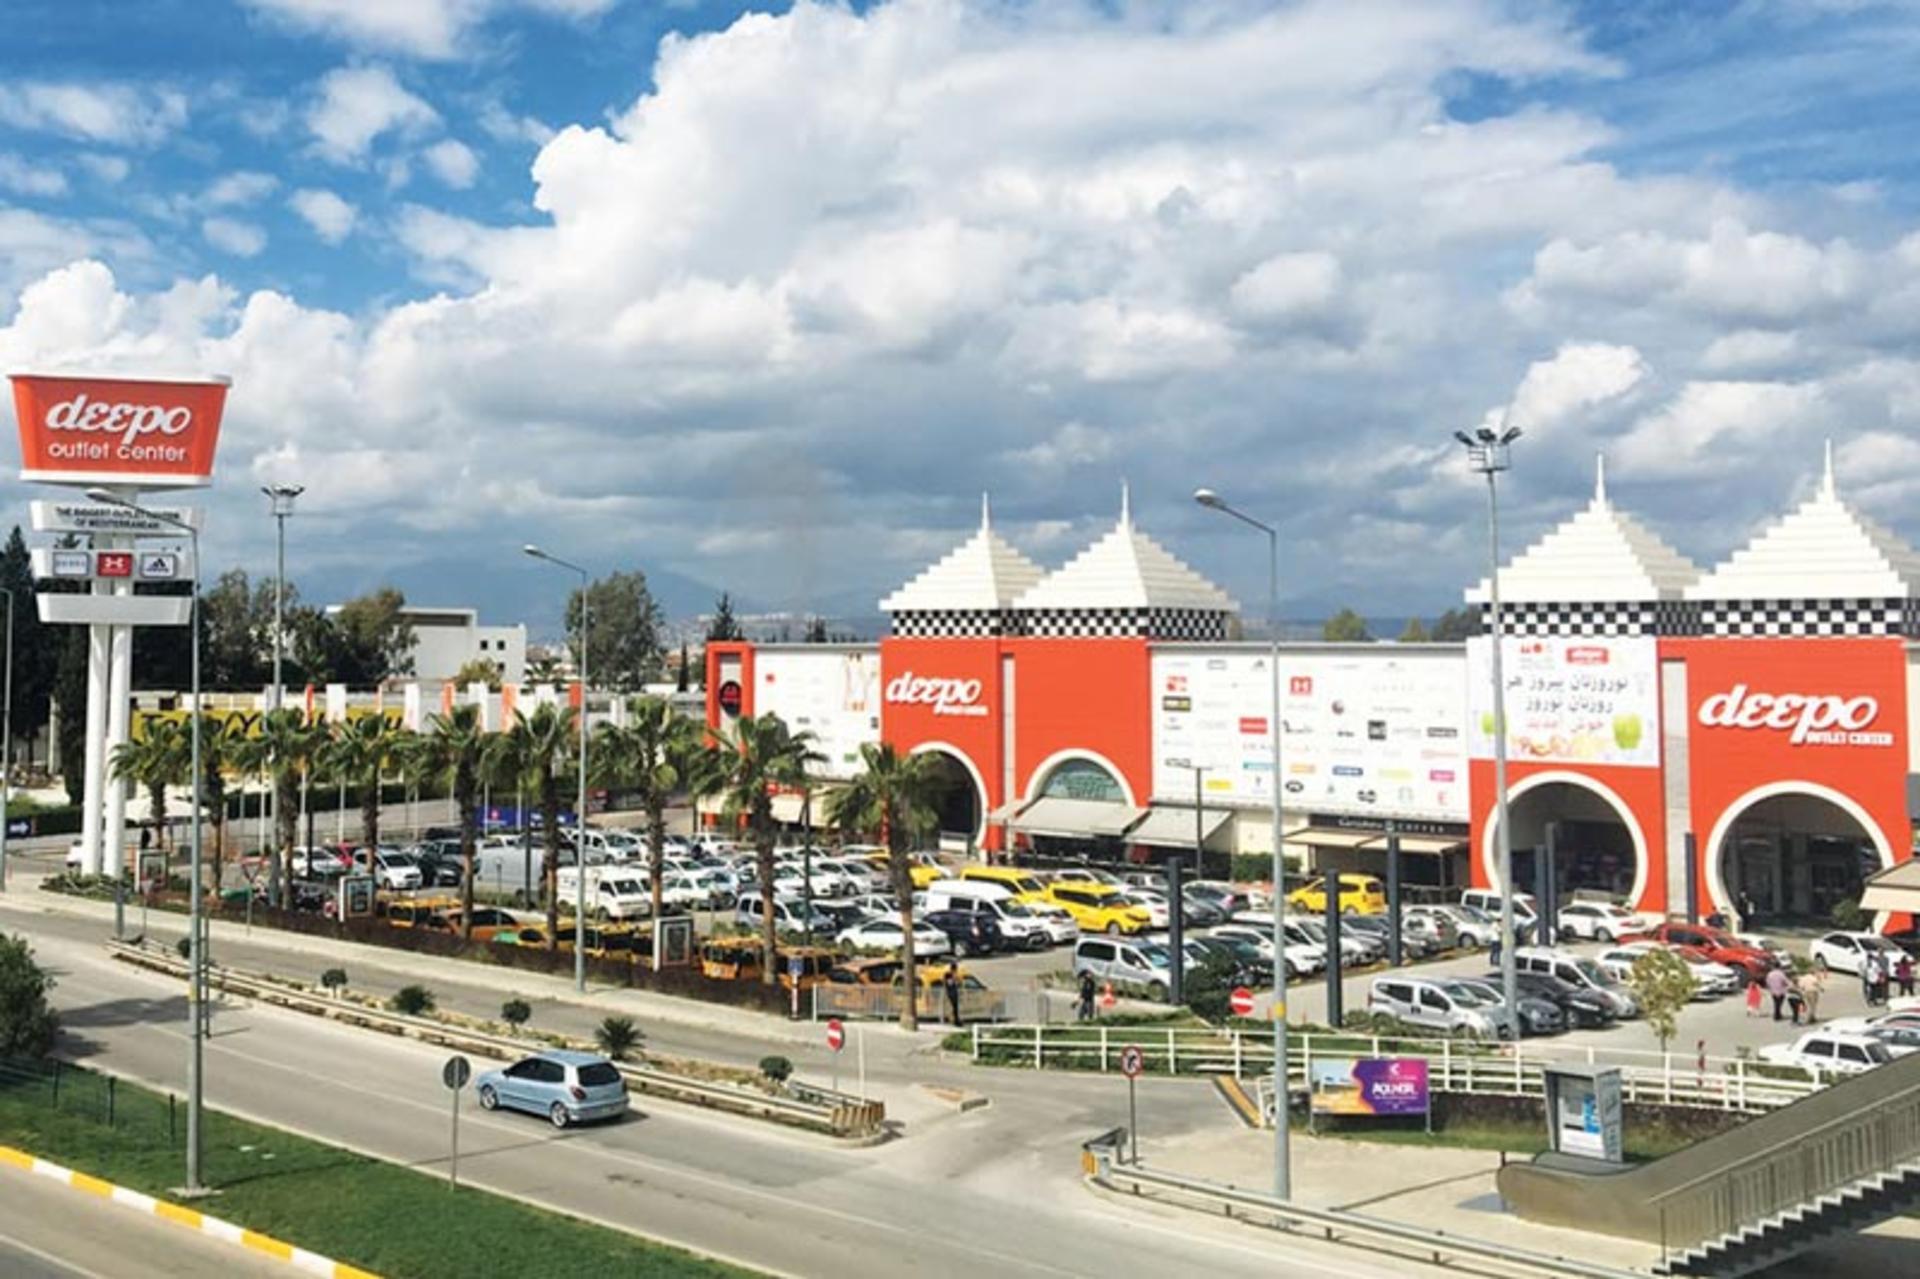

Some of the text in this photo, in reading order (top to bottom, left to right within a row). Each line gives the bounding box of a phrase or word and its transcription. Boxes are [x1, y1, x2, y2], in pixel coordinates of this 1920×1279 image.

[46, 394, 192, 444] deepo
[49, 441, 187, 461] outlet center
[886, 671, 982, 716] deepo
[1698, 683, 1878, 745] deepo
